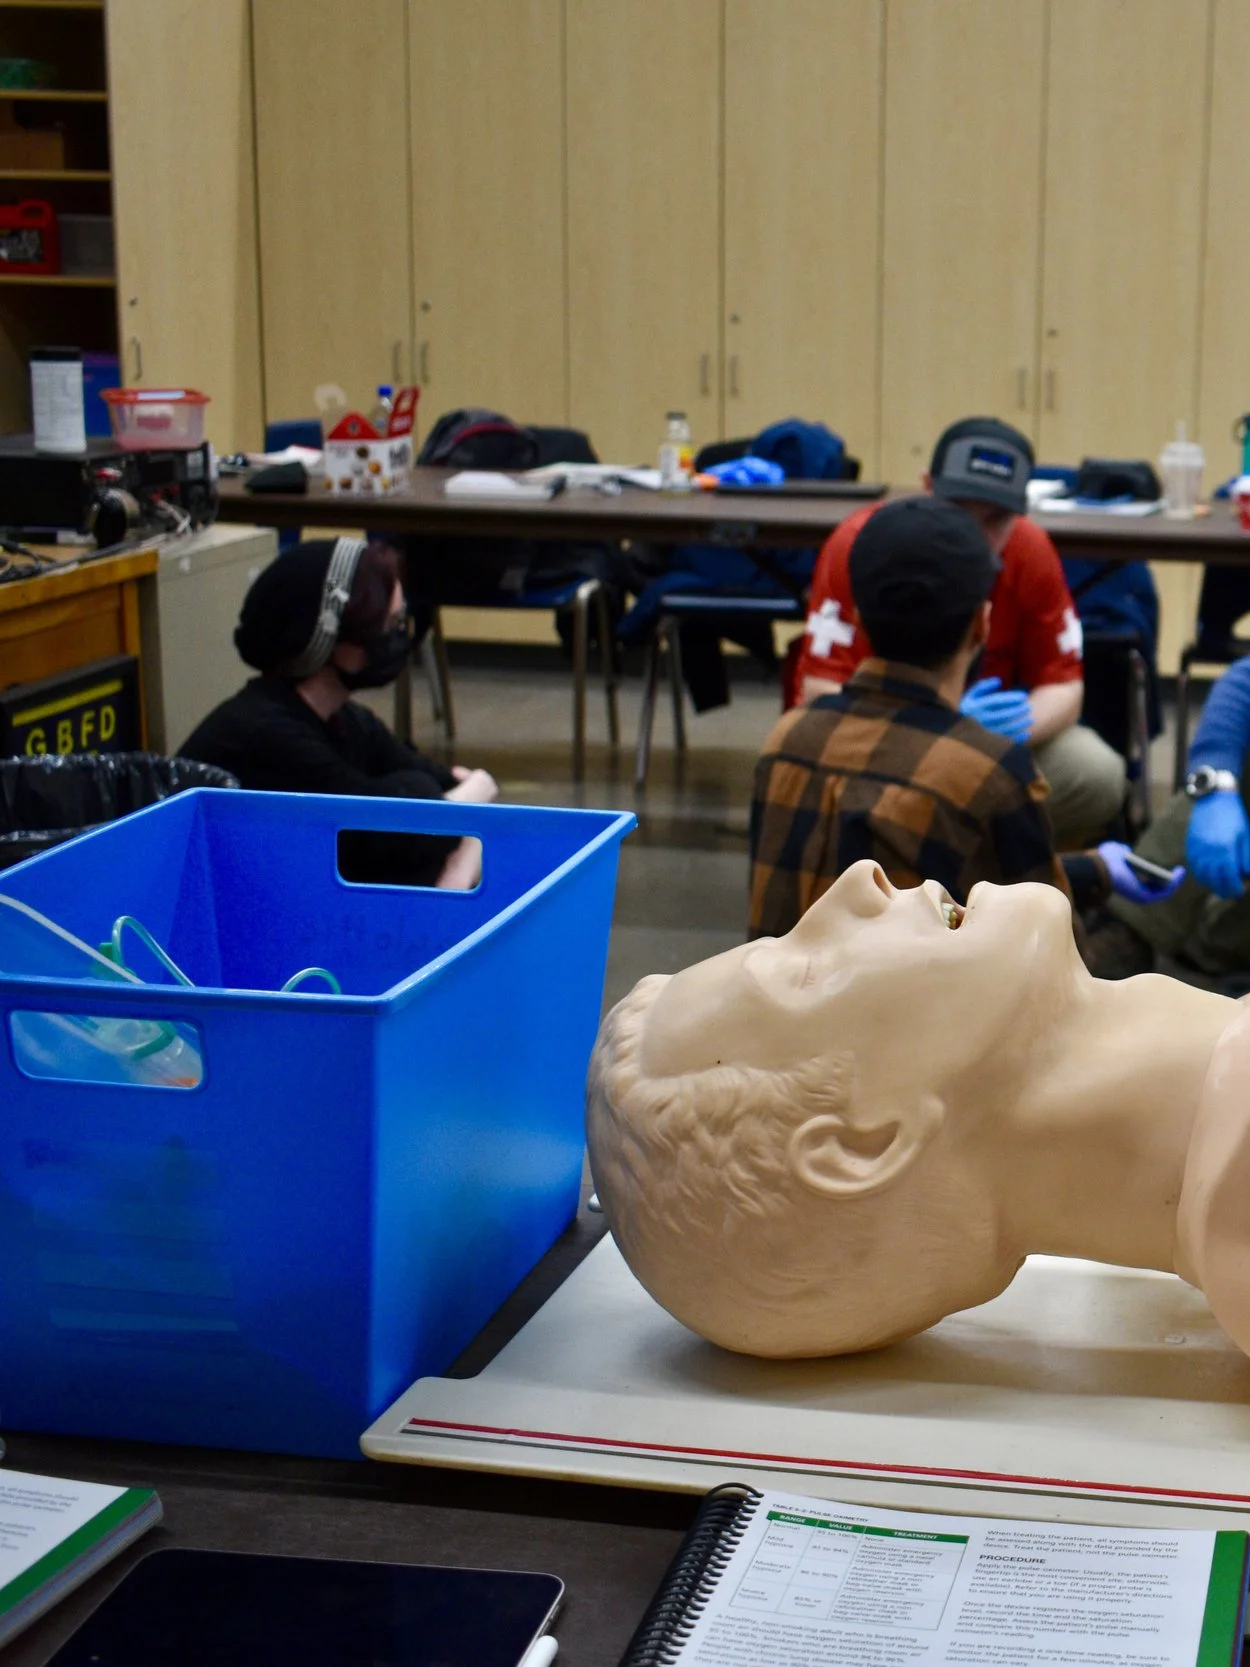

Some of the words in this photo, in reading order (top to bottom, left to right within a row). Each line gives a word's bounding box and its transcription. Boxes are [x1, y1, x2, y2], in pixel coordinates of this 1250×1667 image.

[779, 1514, 806, 1523] RANGE
[828, 1522, 852, 1530] VALUE
[893, 1530, 937, 1539] TREATMENT
[979, 1553, 1047, 1564] PROCEDURE
